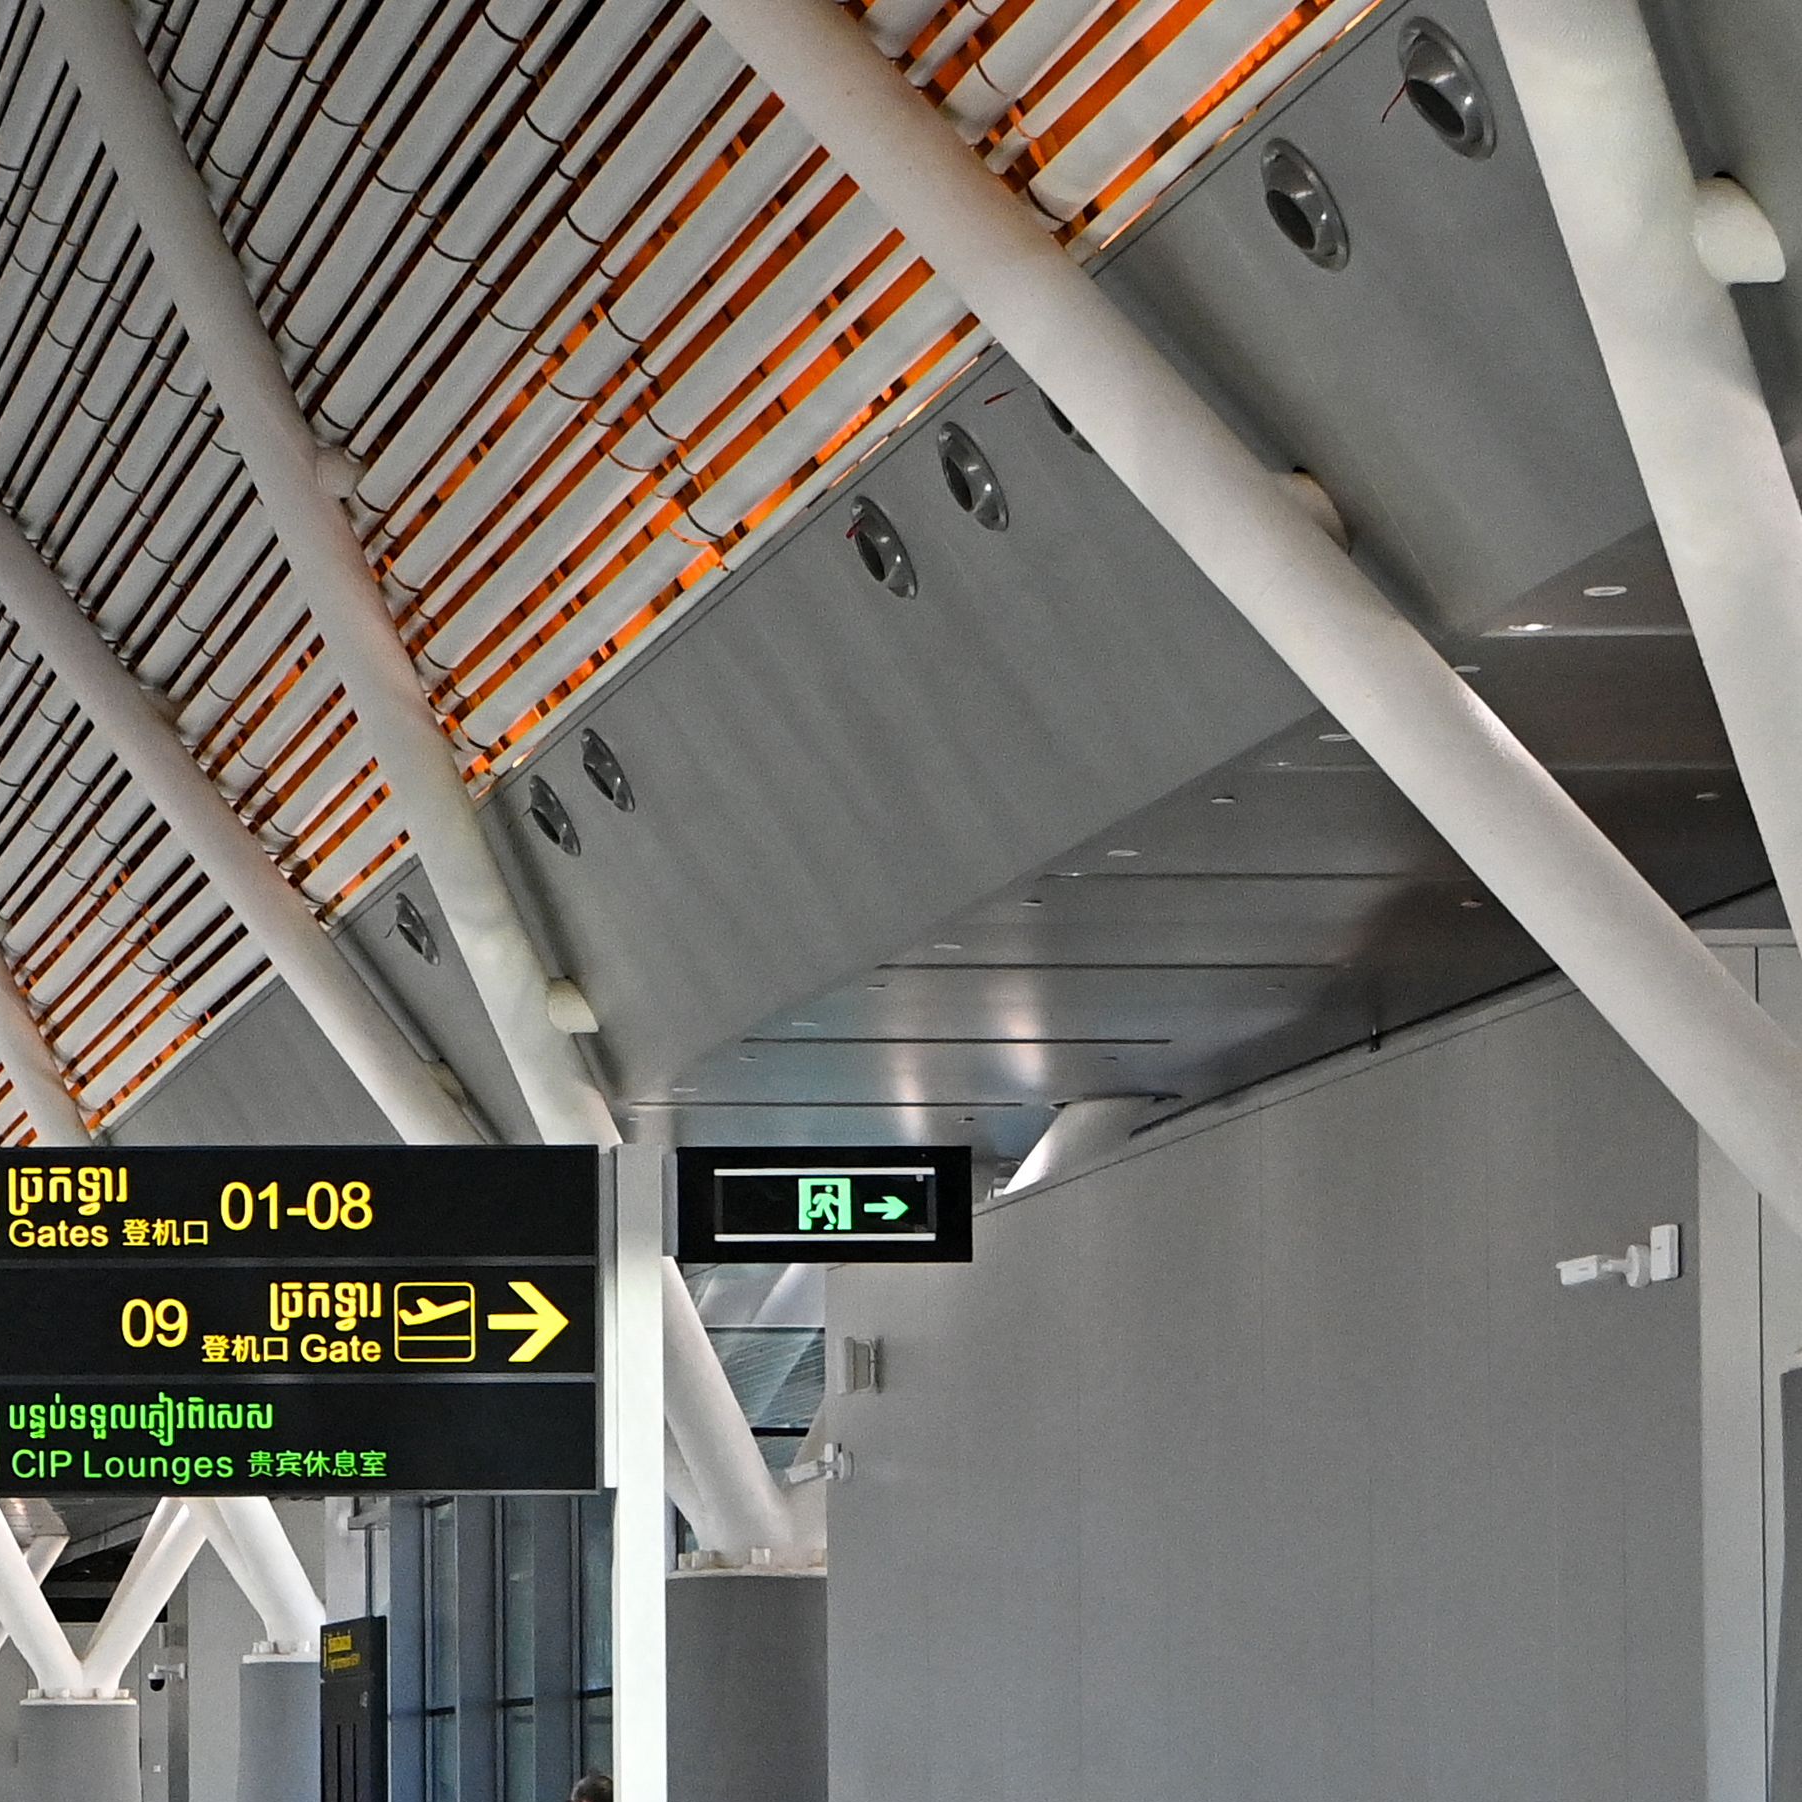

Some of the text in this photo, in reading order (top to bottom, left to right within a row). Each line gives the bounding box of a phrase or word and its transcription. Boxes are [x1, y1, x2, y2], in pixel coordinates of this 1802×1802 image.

[9, 1182, 372, 1247] Gates 登机口 01-08
[122, 1299, 381, 1362] 09 登机口 Gate
[12, 1449, 386, 1484] CIP Lounges 贵宾休息室
